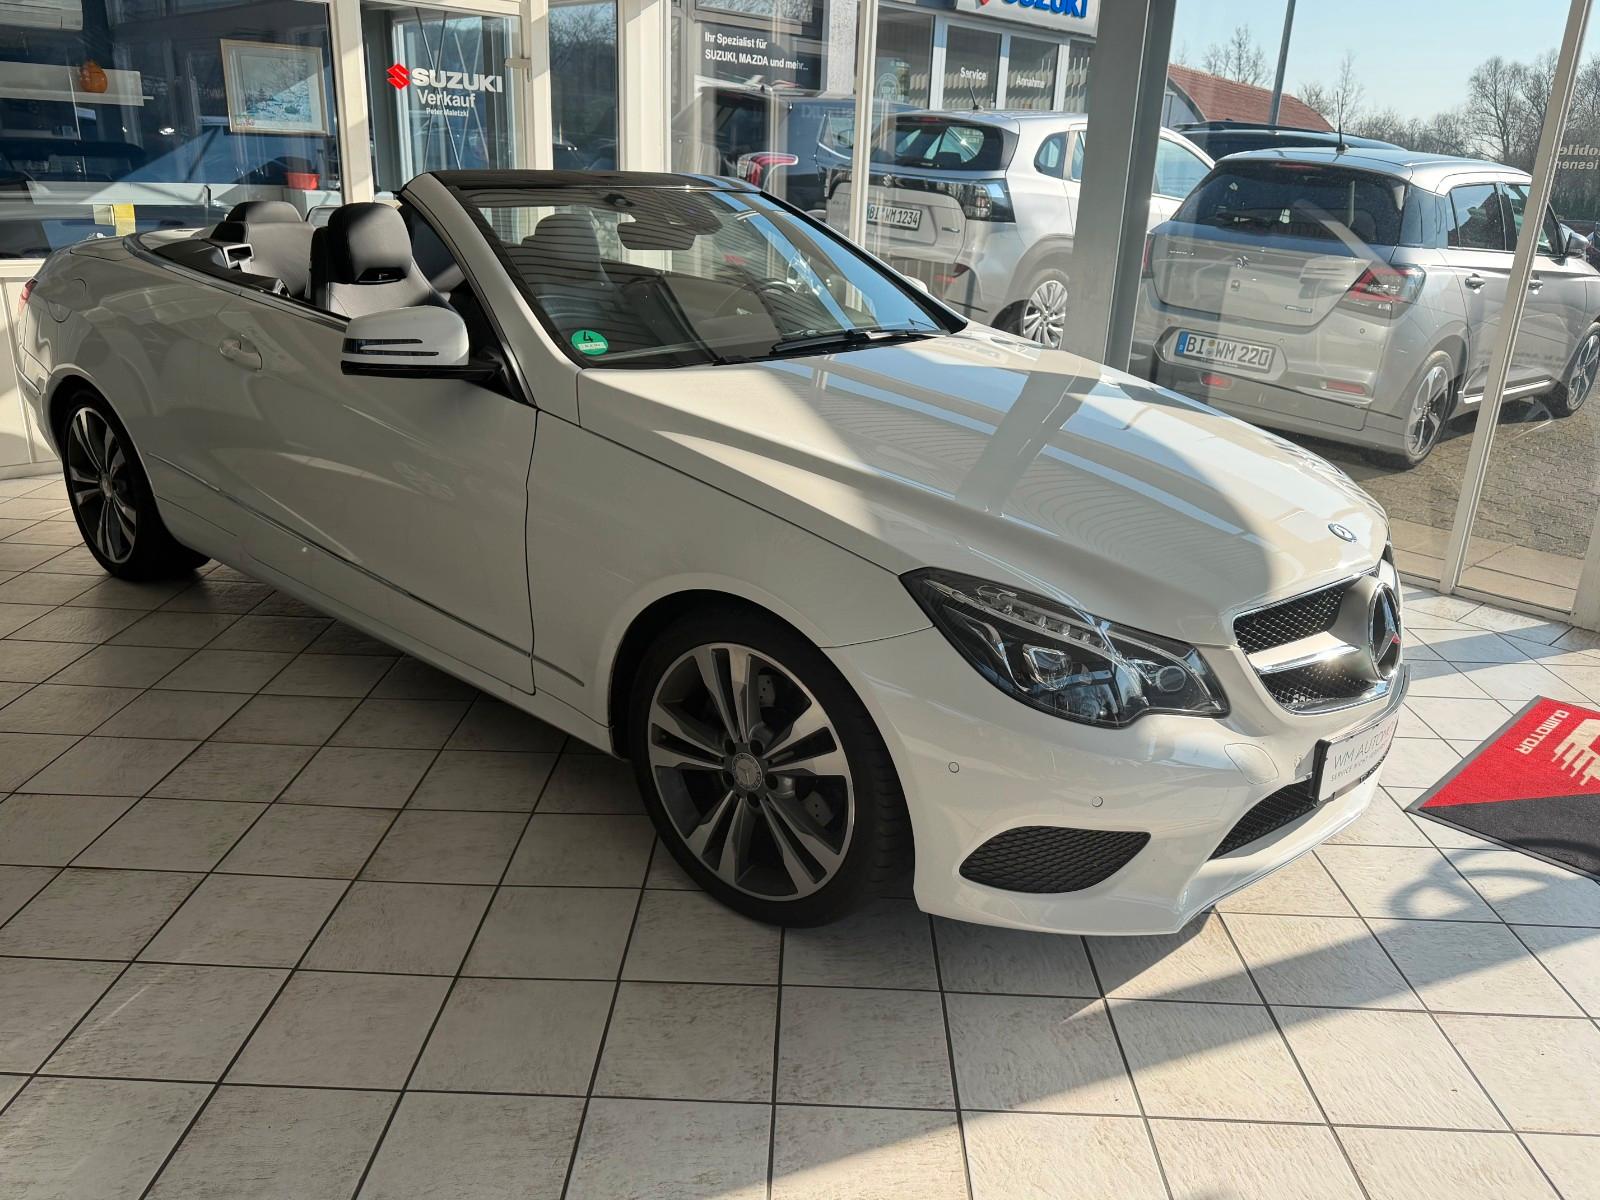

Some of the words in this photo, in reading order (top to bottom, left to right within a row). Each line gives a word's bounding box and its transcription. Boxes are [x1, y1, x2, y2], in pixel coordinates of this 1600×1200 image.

[704, 31, 716, 43] Ihr
[716, 33, 755, 48] Spezialist
[756, 38, 768, 49] für
[704, 49, 737, 65] SUZUKI,
[738, 53, 769, 66] MAZDA
[770, 57, 785, 68] und
[411, 67, 503, 93] SUZUKI
[960, 66, 987, 81] Service
[1015, 74, 1046, 89] Annahme
[417, 89, 476, 108] Verkauf
[869, 206, 880, 220] BI
[897, 210, 918, 225] 1234
[583, 331, 593, 342] 4
[1186, 336, 1206, 355] BI
[1214, 341, 1237, 360] WM
[1237, 346, 1270, 366] 220
[1334, 747, 1355, 770] WM
